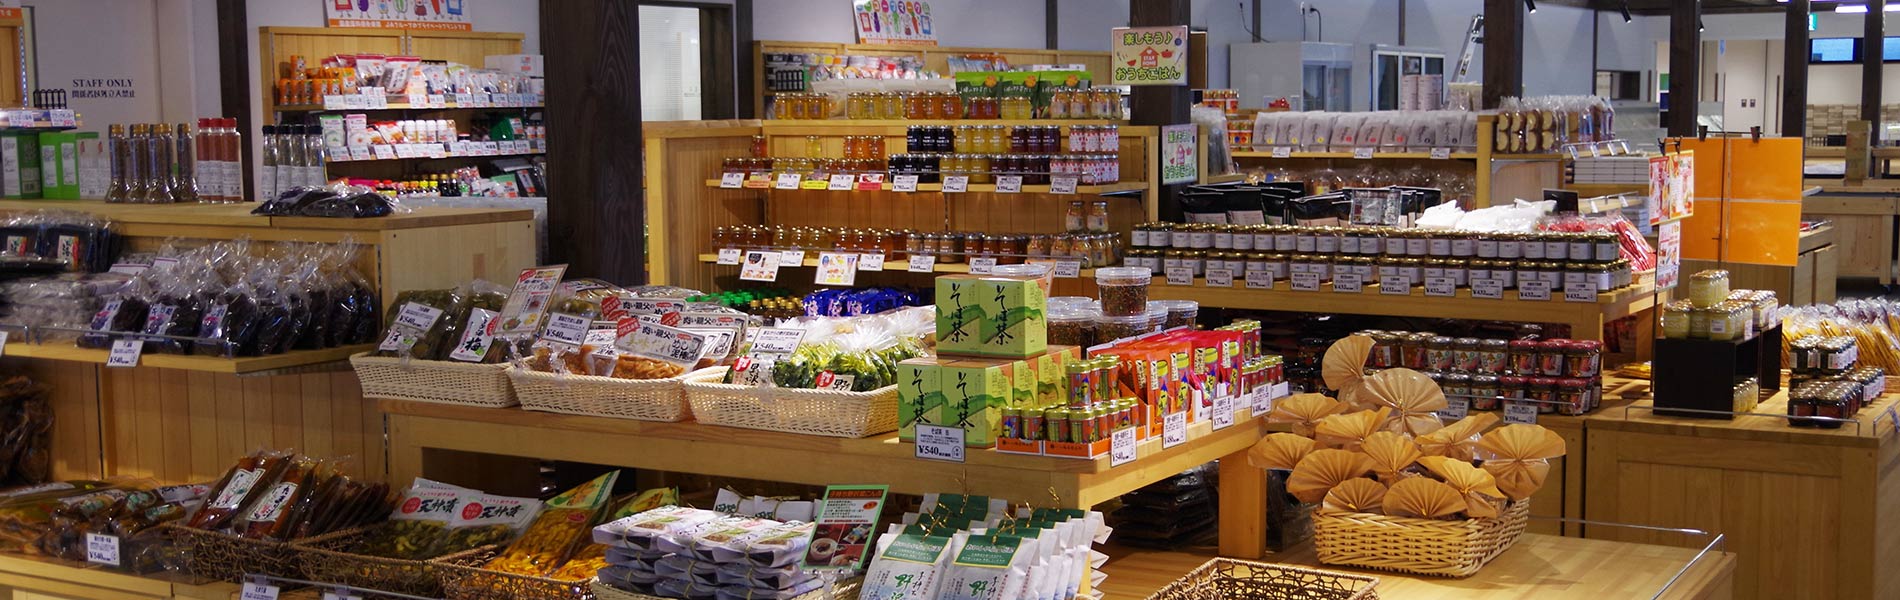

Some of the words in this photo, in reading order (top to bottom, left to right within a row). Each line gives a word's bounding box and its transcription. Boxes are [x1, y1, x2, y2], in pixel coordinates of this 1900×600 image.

[72, 79, 103, 88] STAFF
[106, 79, 134, 88] ONLY
[1115, 65, 1181, 81] おうちごはん
[950, 282, 969, 344] そば茶
[994, 284, 1014, 346] そば茶
